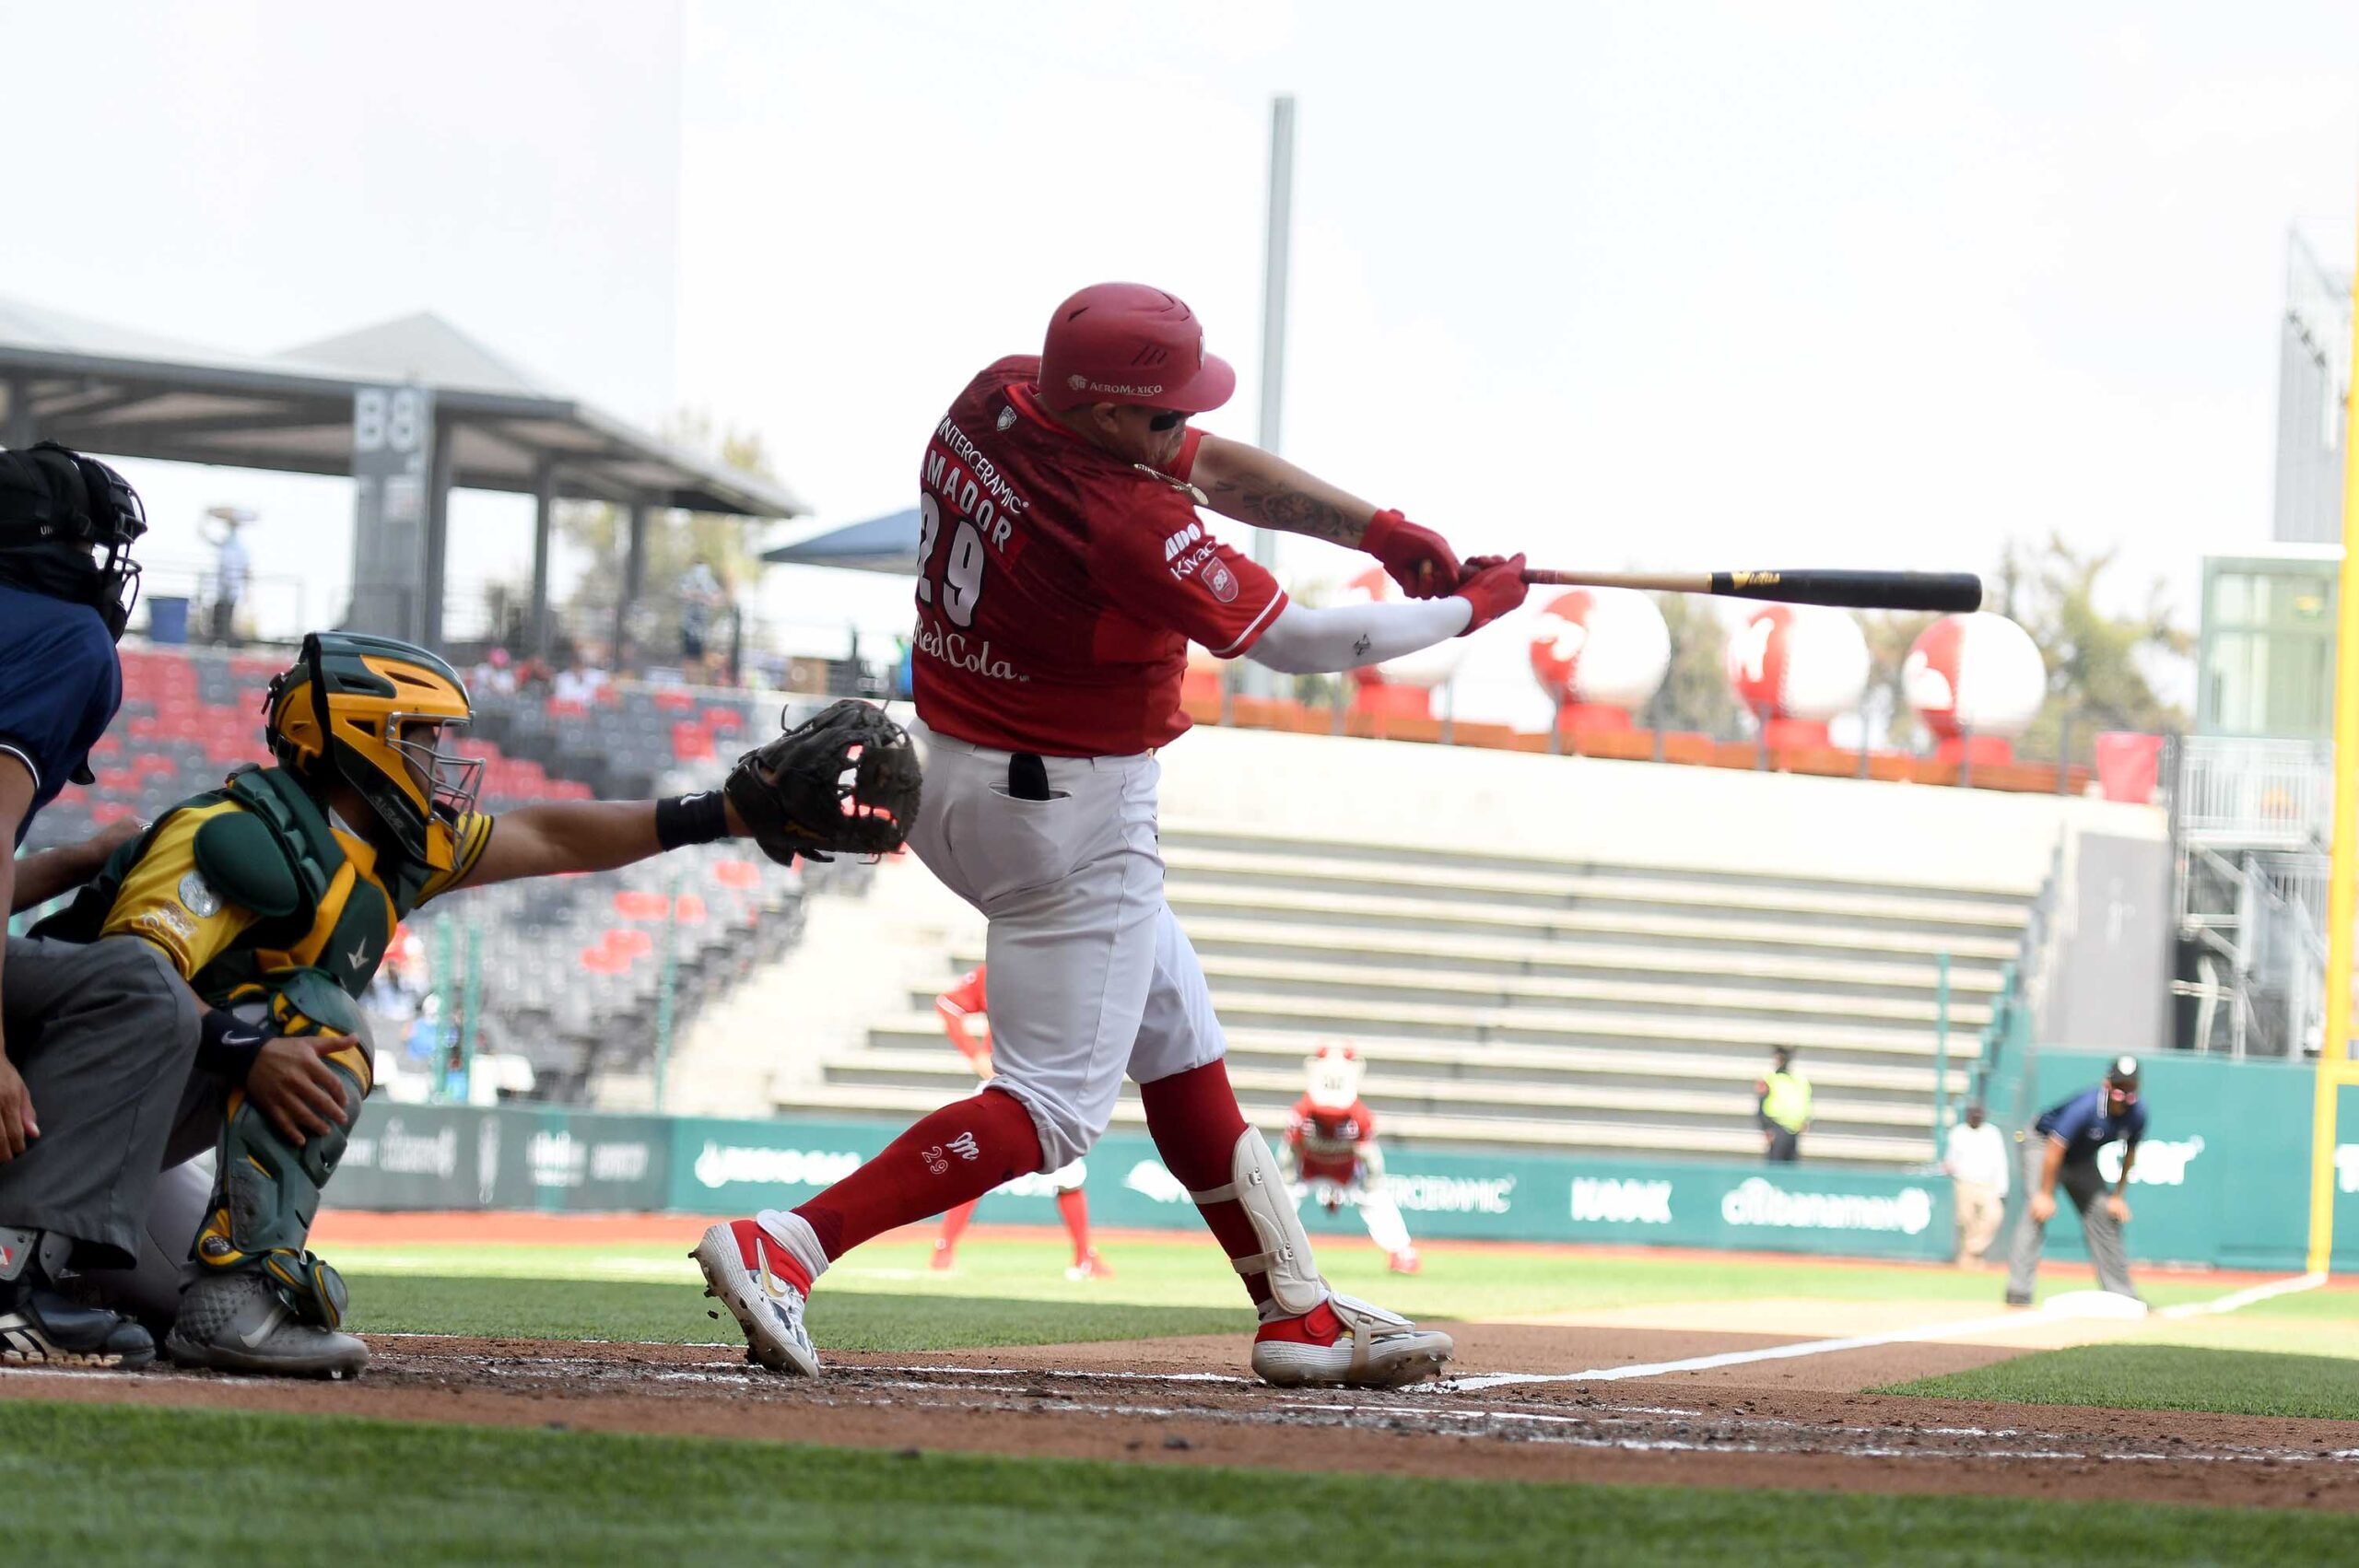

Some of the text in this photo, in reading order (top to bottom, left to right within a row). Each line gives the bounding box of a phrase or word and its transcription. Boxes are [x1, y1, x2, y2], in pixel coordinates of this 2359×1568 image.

[921, 450, 1012, 553] MADOR
[1166, 523, 1201, 562] ADO
[921, 1145, 948, 1175] 29
